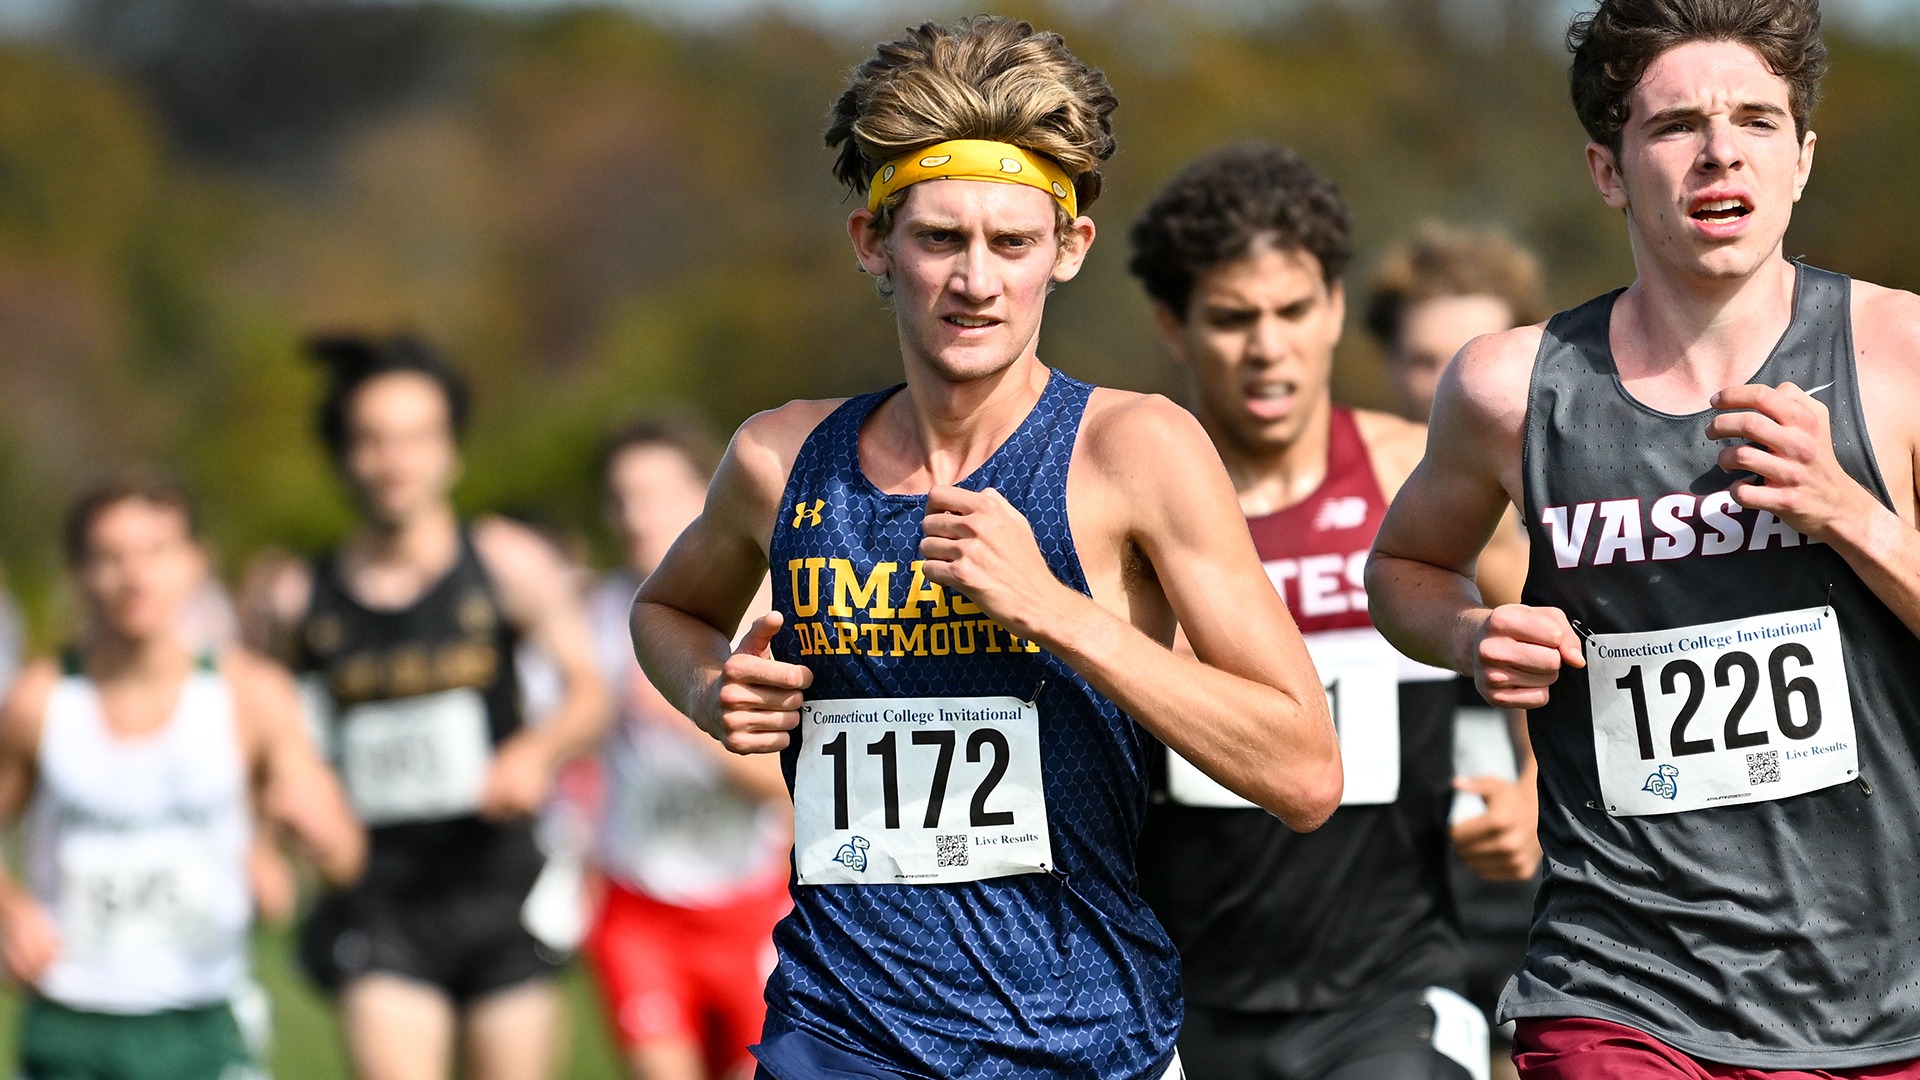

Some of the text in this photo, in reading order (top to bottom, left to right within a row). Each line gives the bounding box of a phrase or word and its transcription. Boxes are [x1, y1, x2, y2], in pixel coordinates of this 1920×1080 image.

[1541, 490, 1825, 570] VASSA
[1598, 618, 1822, 659] Connecticut College Invitational
[813, 707, 1022, 725] Connecticut College Invitational
[1615, 642, 1823, 761] 1226
[1786, 742, 1848, 760] Live Results
[821, 728, 1015, 830] 1172
[975, 833, 1039, 846] Live Results
